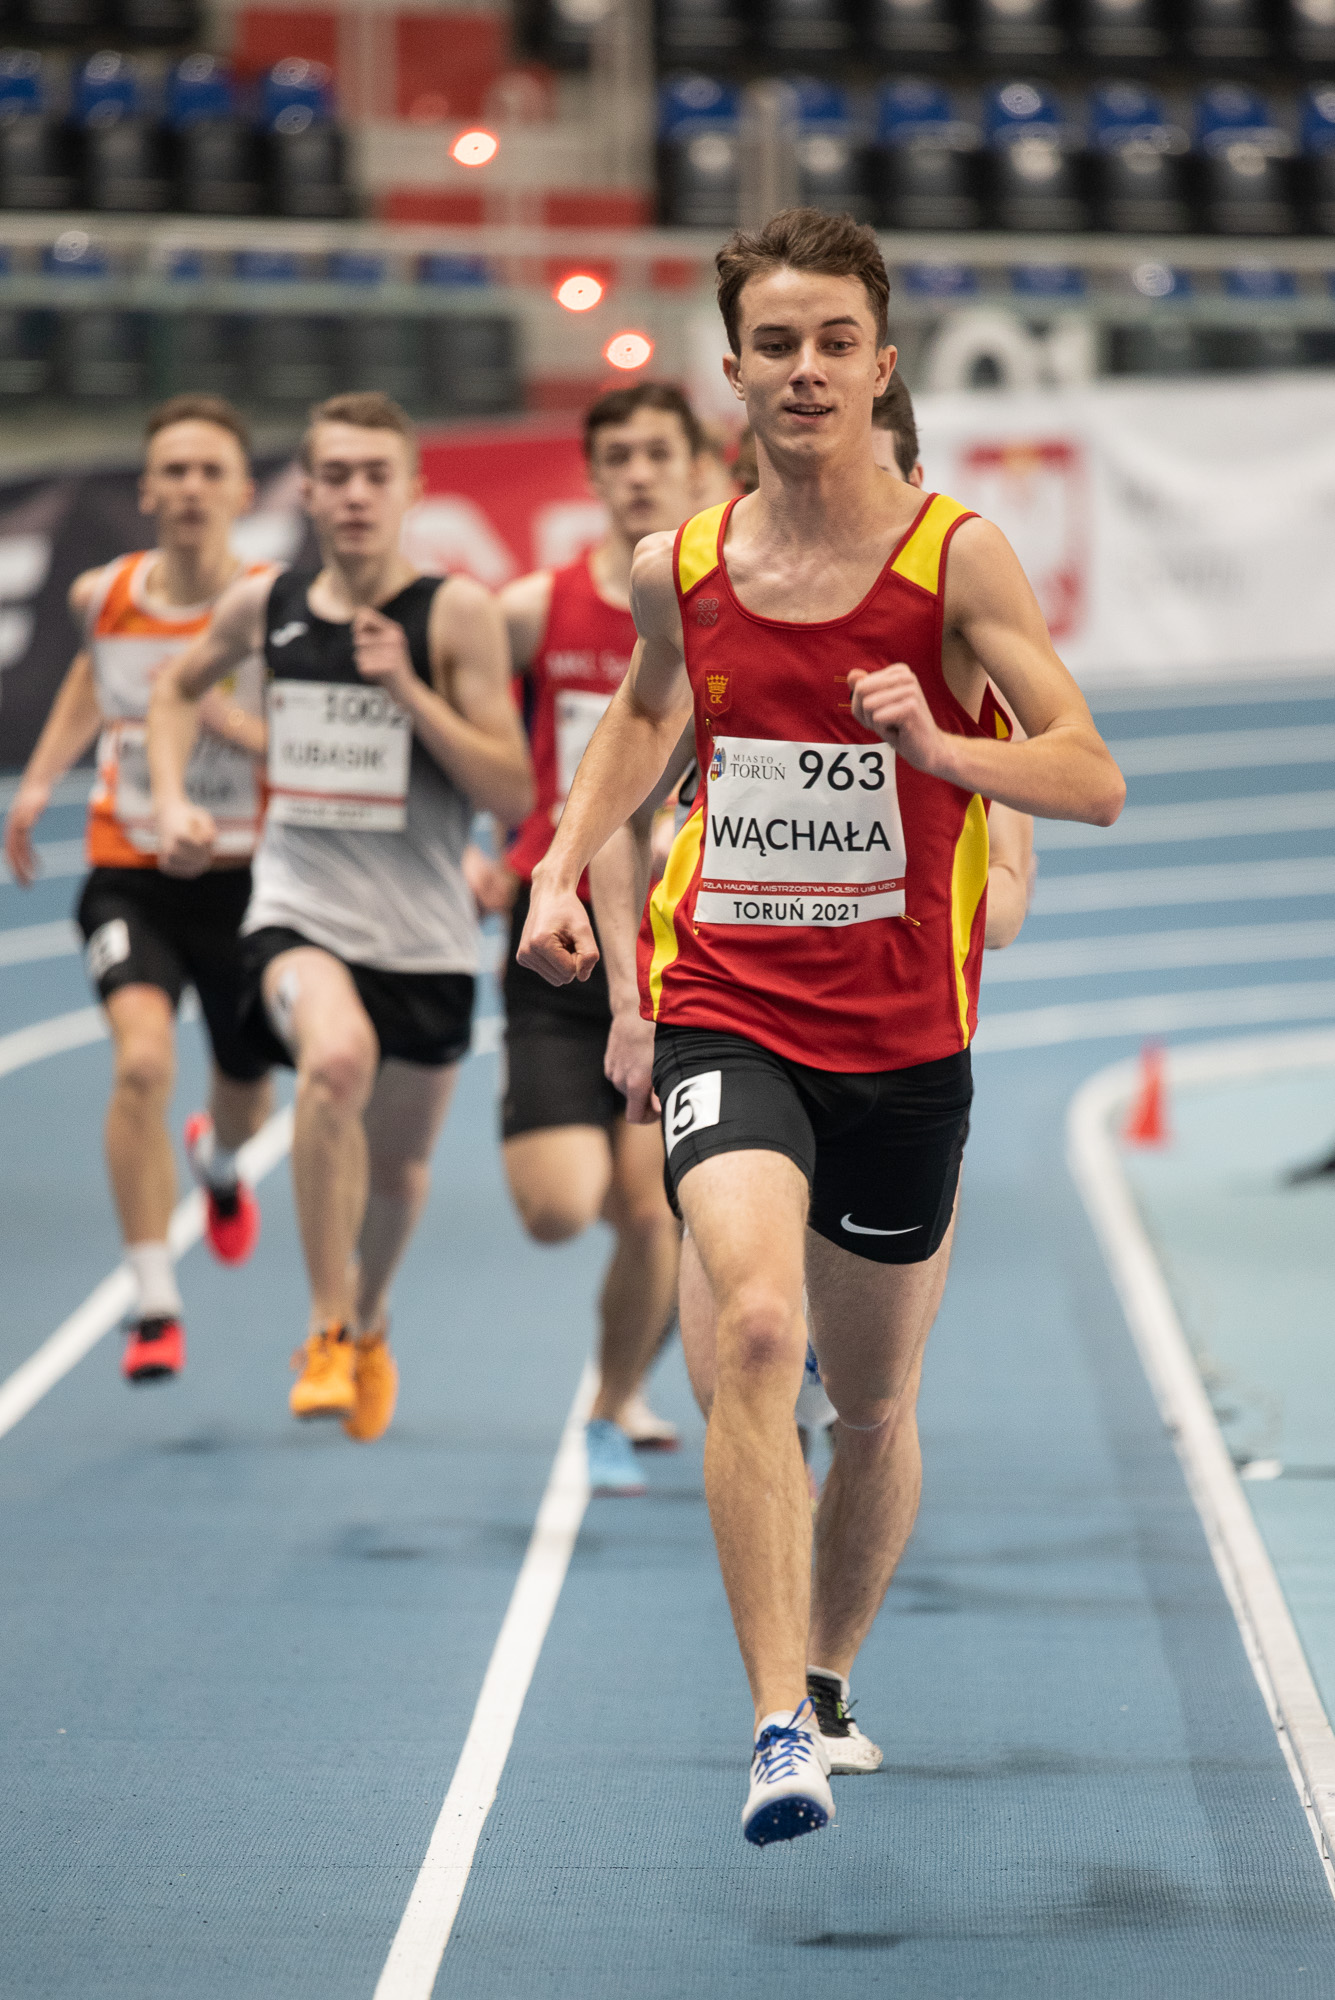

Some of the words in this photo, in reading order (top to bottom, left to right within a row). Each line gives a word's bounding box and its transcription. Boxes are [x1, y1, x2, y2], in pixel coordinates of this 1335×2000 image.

[732, 754, 774, 764] MIASTO
[799, 750, 885, 791] 963
[730, 763, 786, 781] TORUŃ
[712, 815, 891, 857] WĄCHAŁA
[703, 881, 723, 890] PZLA
[723, 883, 759, 892] HALOWE
[760, 885, 826, 893] MISTRZOSTWA
[827, 886, 859, 894] POLSKI
[878, 882, 897, 890] U20
[733, 897, 804, 921] TORUŃ
[812, 903, 859, 921] 2021
[673, 1081, 697, 1136] 5
